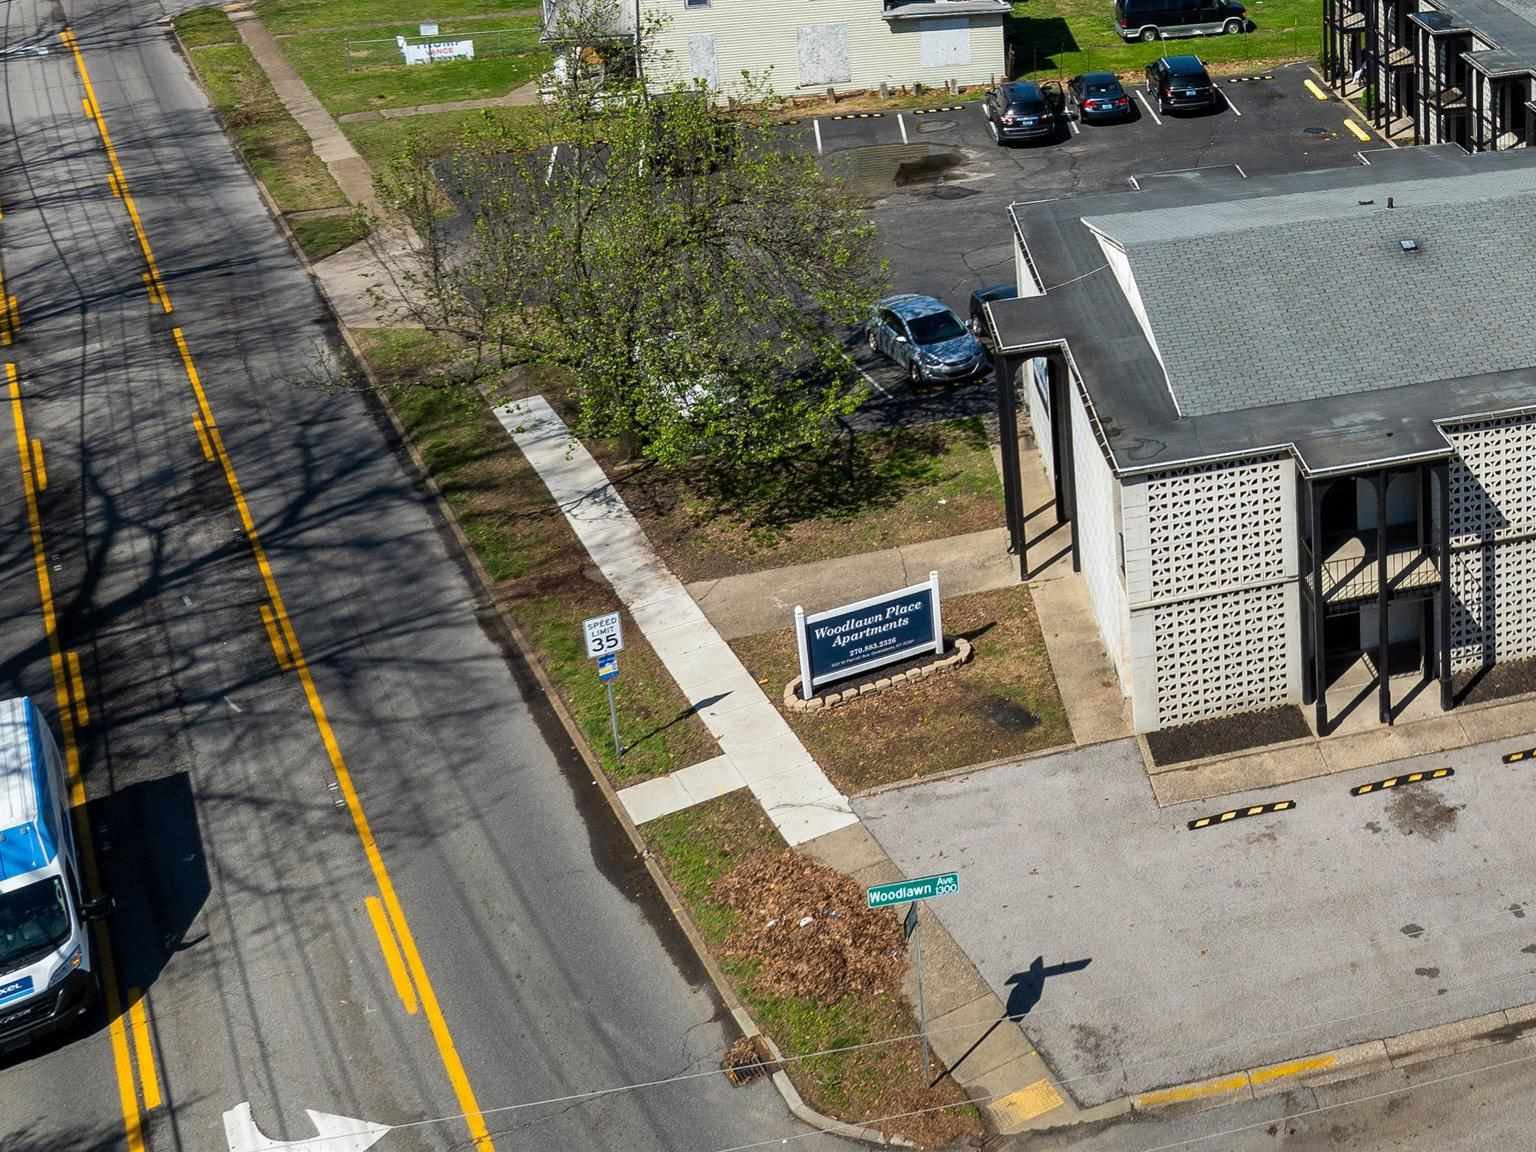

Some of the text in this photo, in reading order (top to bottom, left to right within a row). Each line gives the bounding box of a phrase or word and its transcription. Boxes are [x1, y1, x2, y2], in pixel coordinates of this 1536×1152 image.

[587, 617, 617, 631] SPEED
[814, 601, 923, 641] Woodlawn Place
[591, 626, 615, 638] LIMIT
[831, 616, 910, 647] Apartments
[592, 633, 618, 652] 35
[869, 884, 932, 904] Woodlawn
